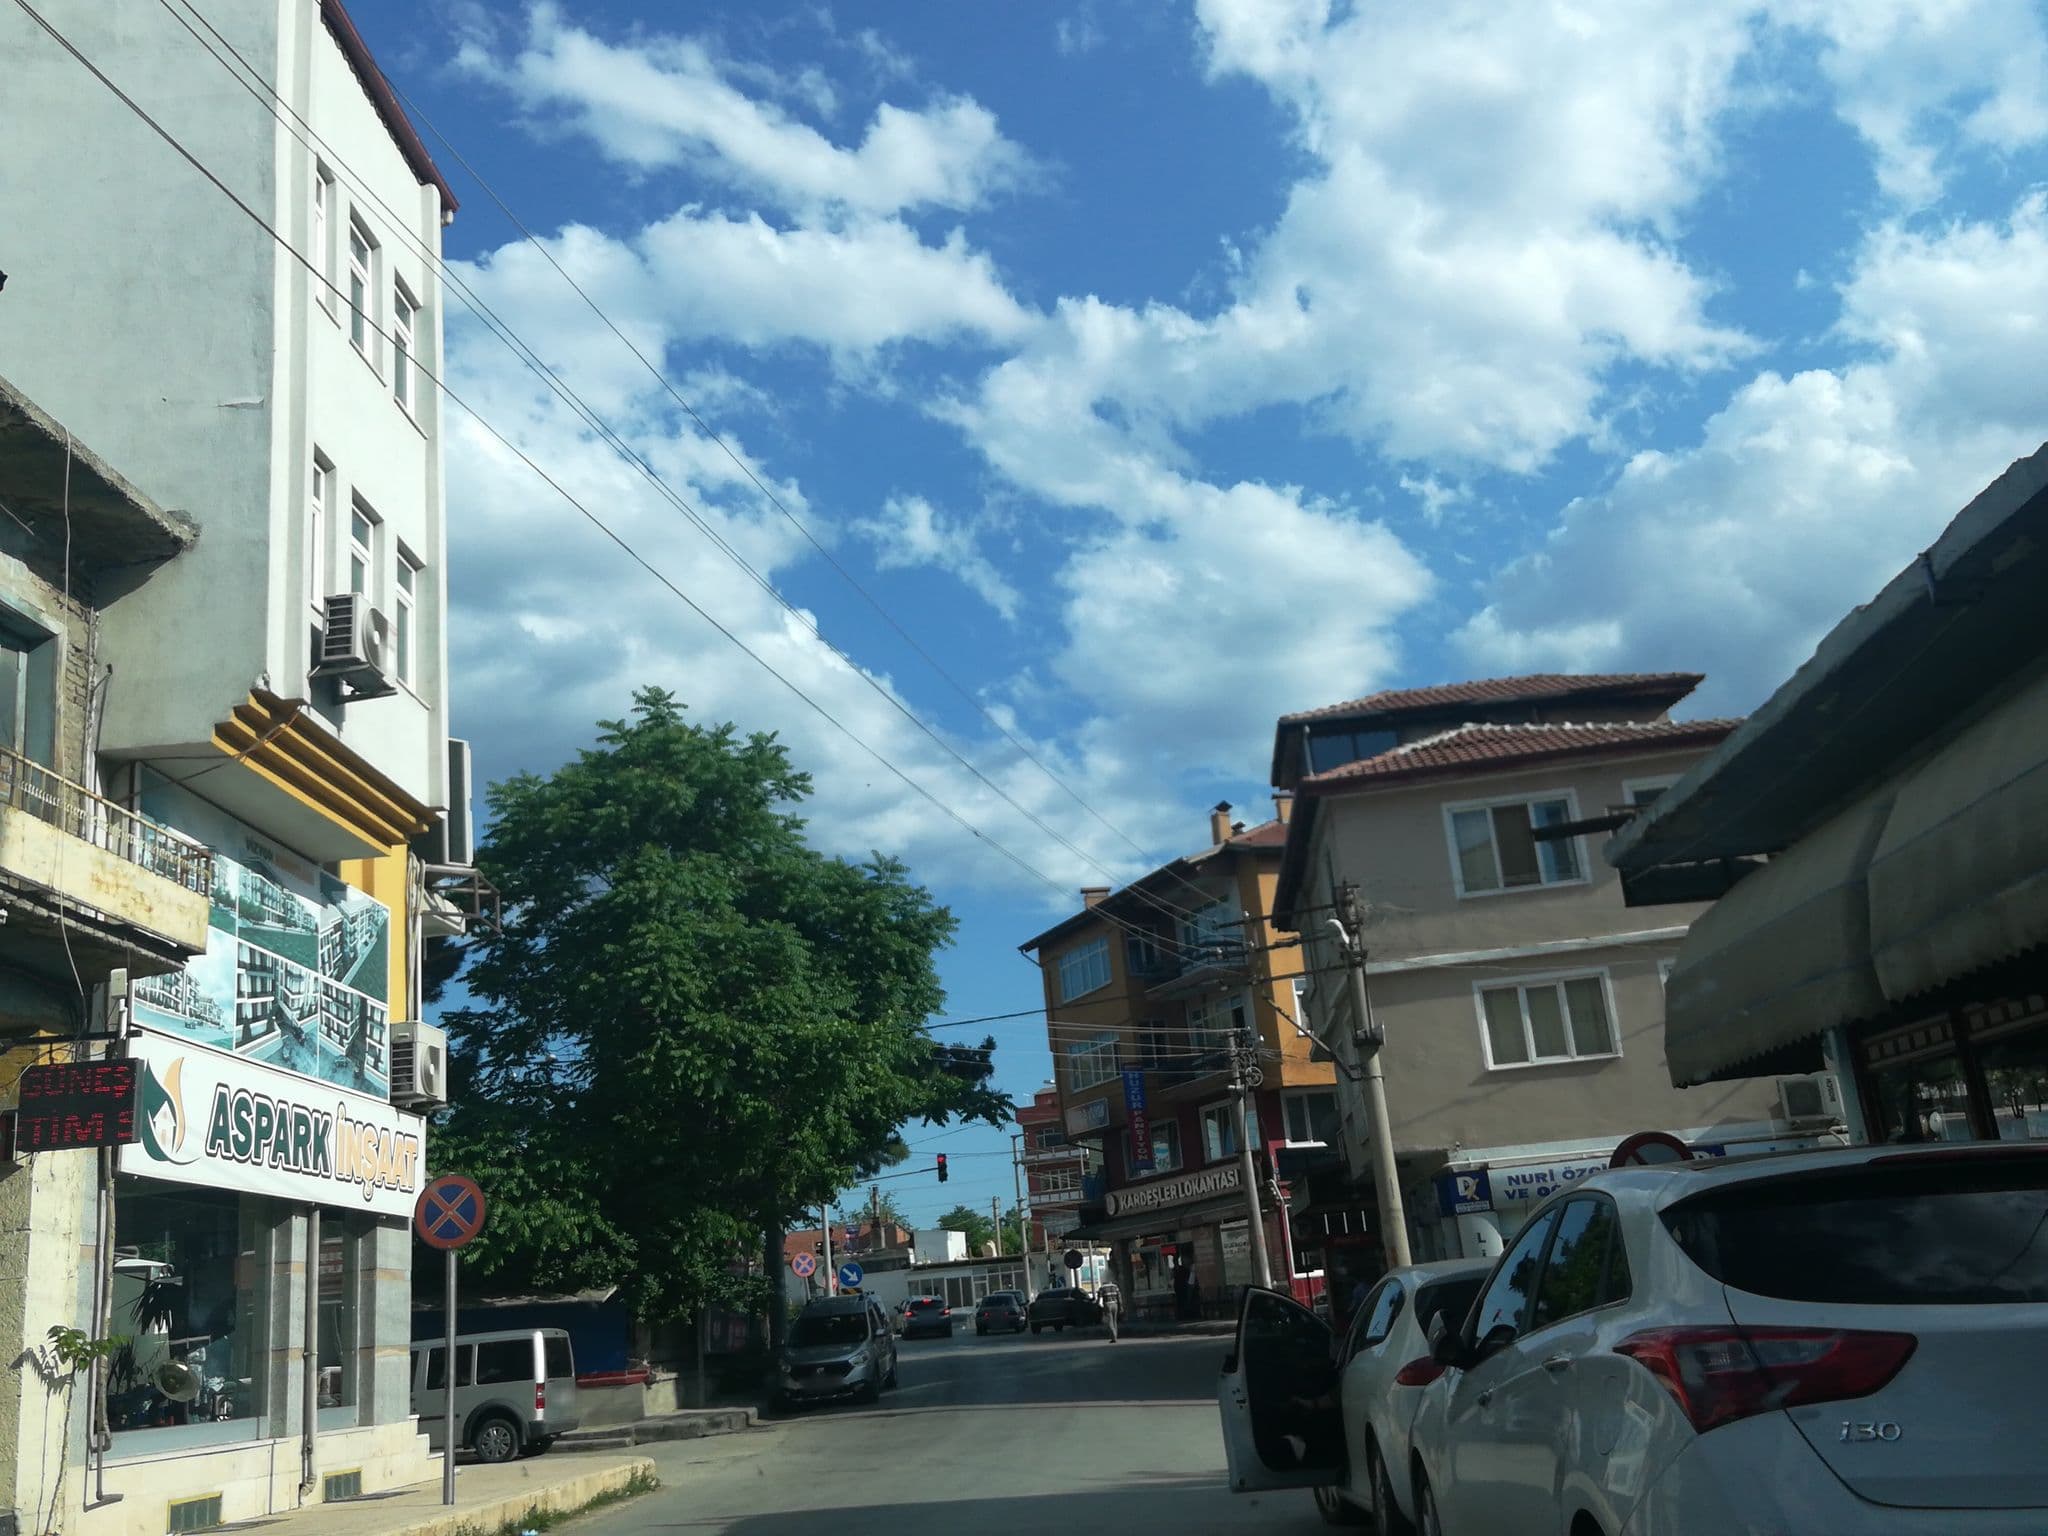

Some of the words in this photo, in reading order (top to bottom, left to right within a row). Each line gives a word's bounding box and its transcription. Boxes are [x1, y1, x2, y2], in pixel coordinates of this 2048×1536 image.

[206, 1082, 332, 1178] ASPARK
[335, 1101, 418, 1201] İNŞAAT
[1507, 1169, 1555, 1186] NURİ
[1120, 1185, 1177, 1210] KARDEŞLER
[1178, 1169, 1240, 1197] LOKANTASI
[1504, 1188, 1529, 1200] VE
[1840, 1421, 1902, 1441] i30
